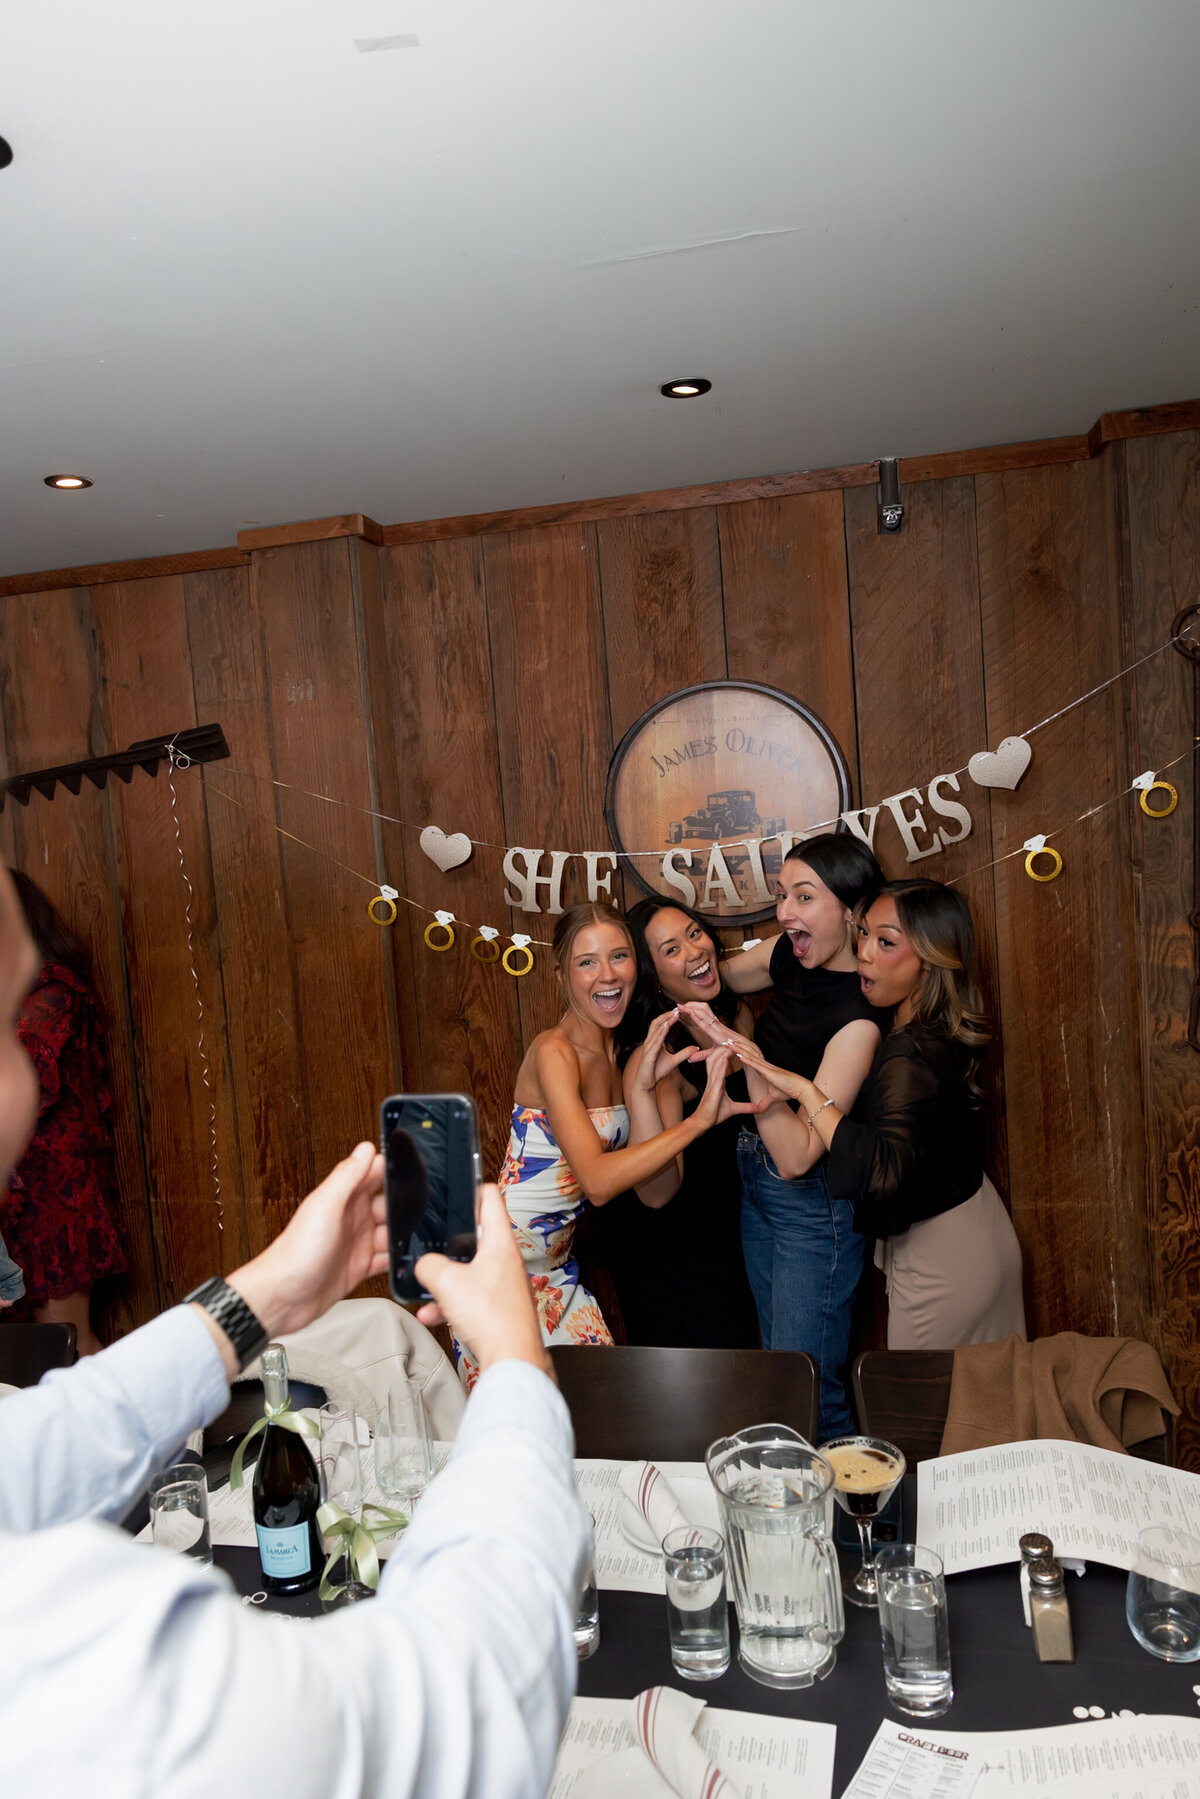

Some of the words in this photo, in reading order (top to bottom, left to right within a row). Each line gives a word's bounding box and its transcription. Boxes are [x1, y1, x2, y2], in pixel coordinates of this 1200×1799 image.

[503, 847, 618, 914] SHE
[841, 774, 972, 862] YES
[898, 1733, 938, 1751] CRAFT
[938, 1746, 969, 1760] BEER
